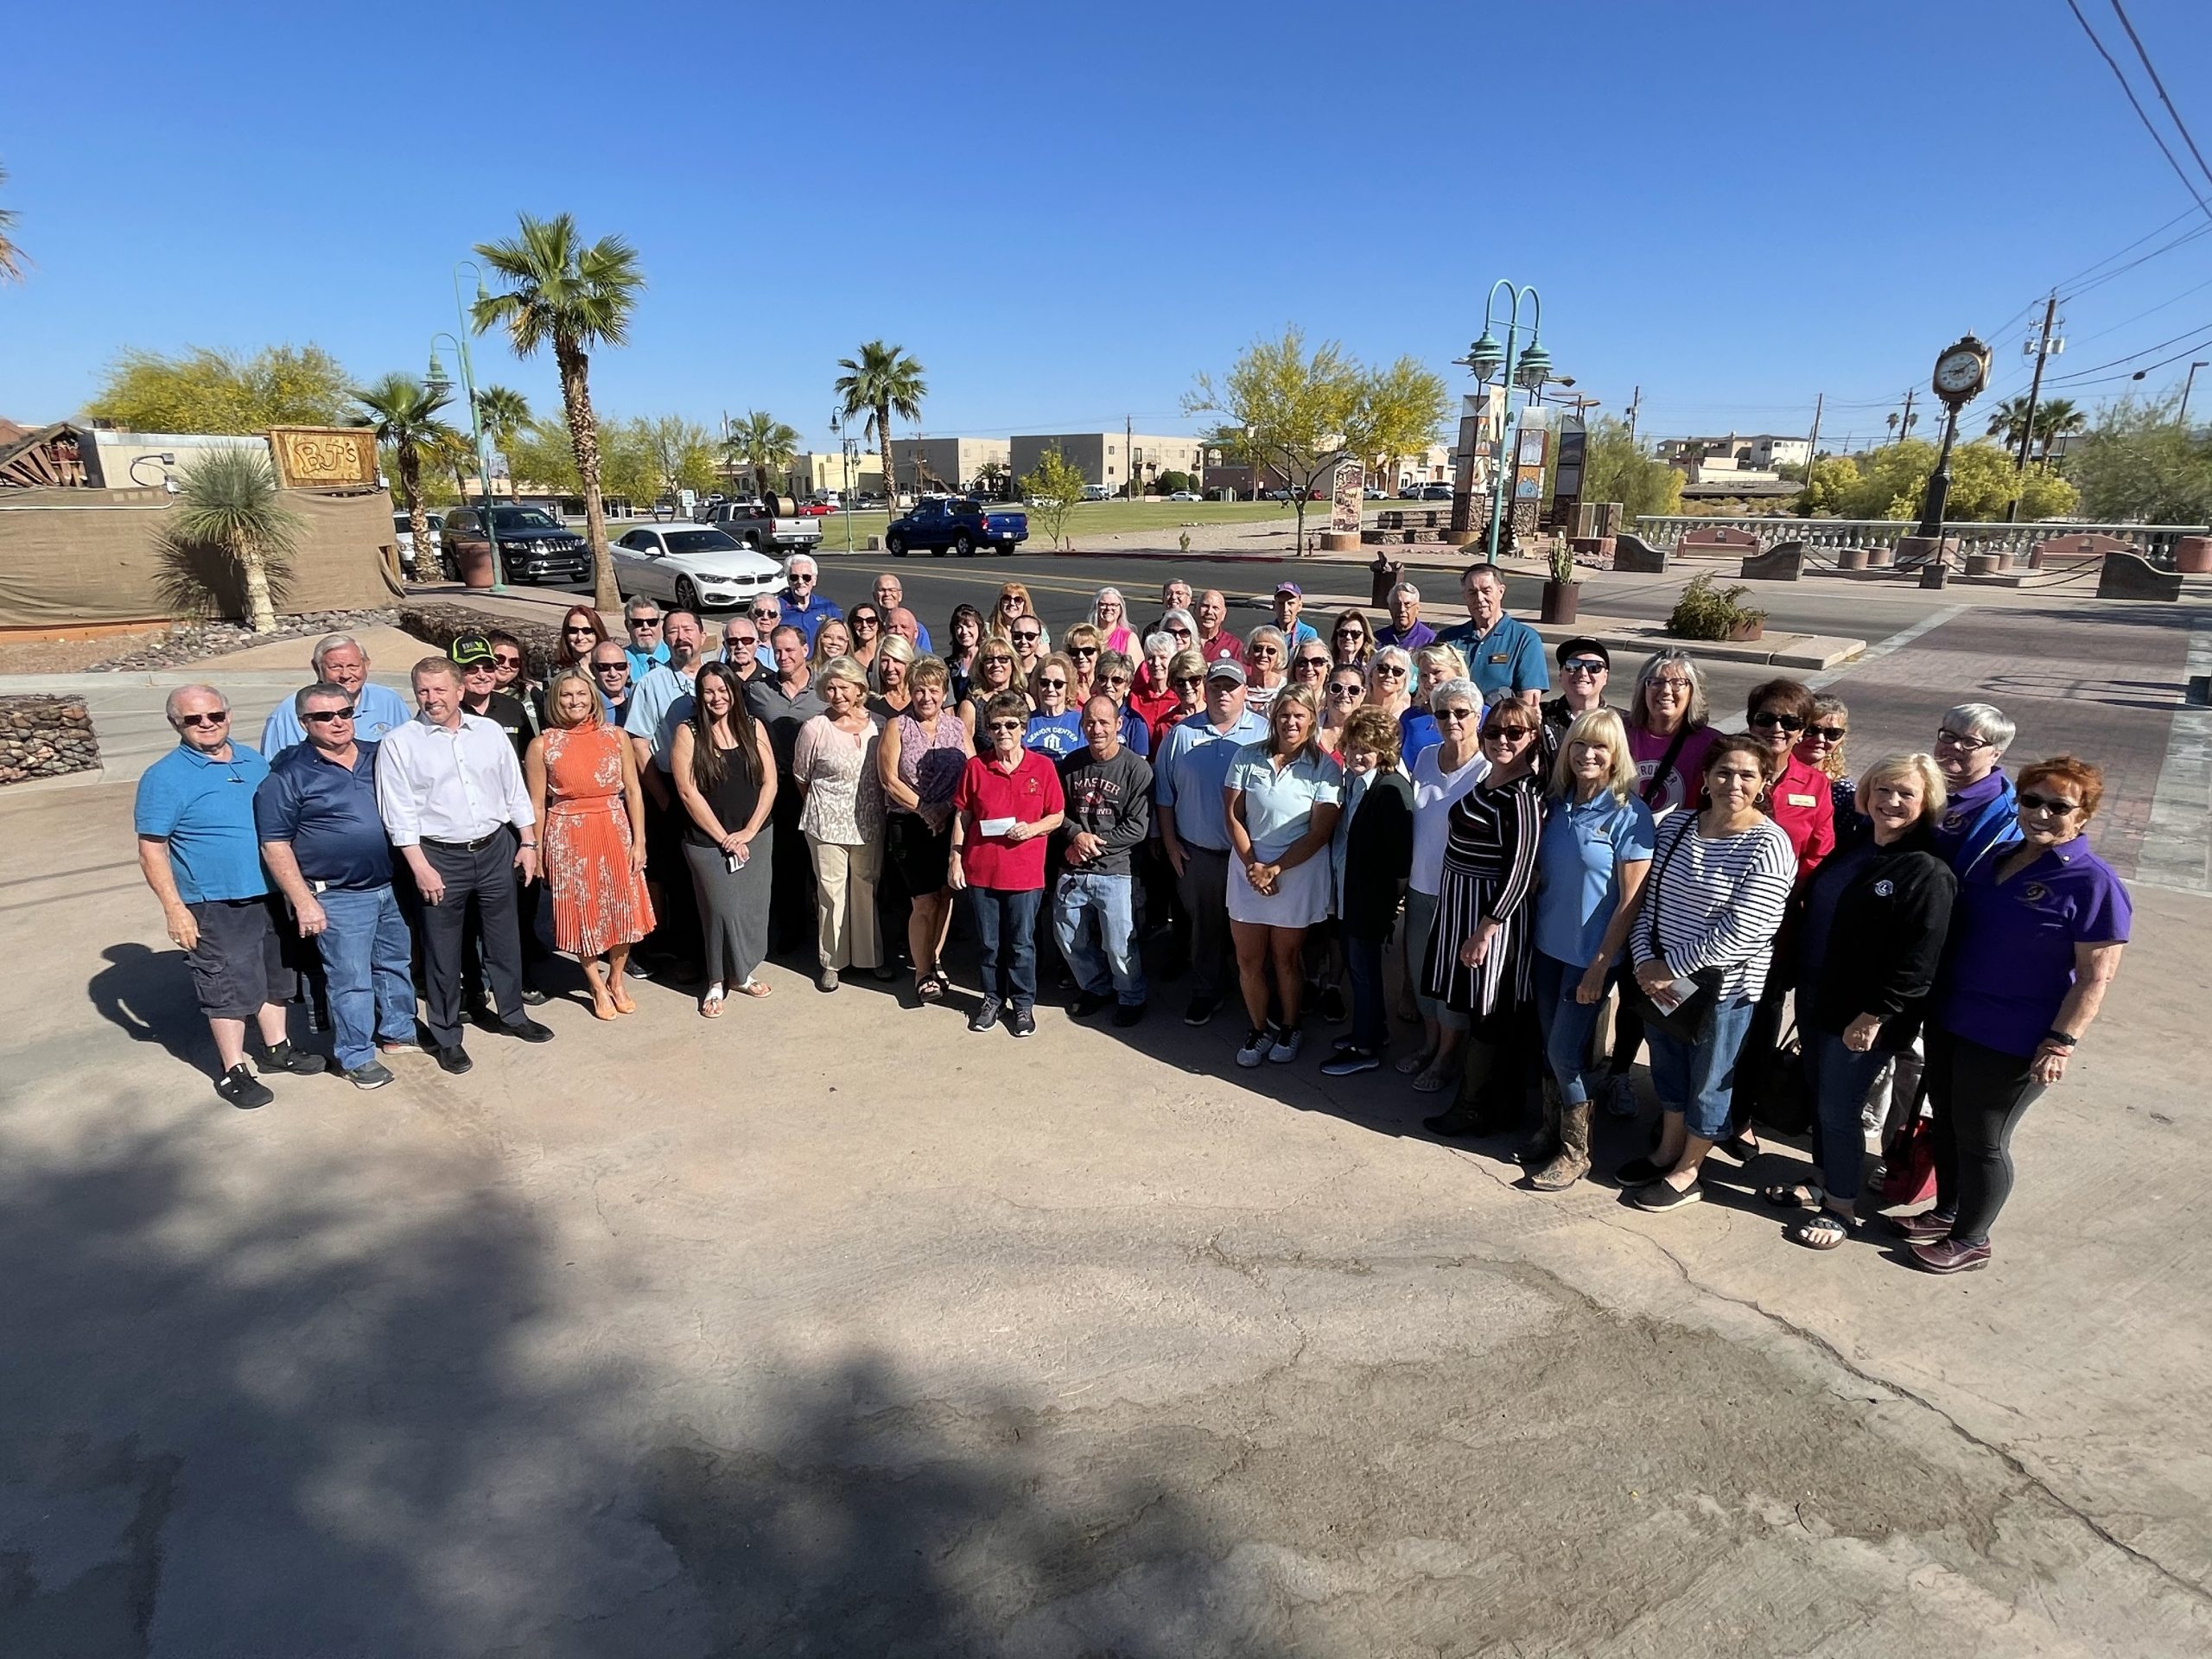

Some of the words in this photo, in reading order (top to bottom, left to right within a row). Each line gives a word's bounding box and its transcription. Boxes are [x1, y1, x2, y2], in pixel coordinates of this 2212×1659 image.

[295, 442, 357, 474] BJ's
[1027, 727, 1052, 743] SENIOR
[1052, 727, 1078, 743] CENTER
[1074, 778, 1121, 796] MASTER
